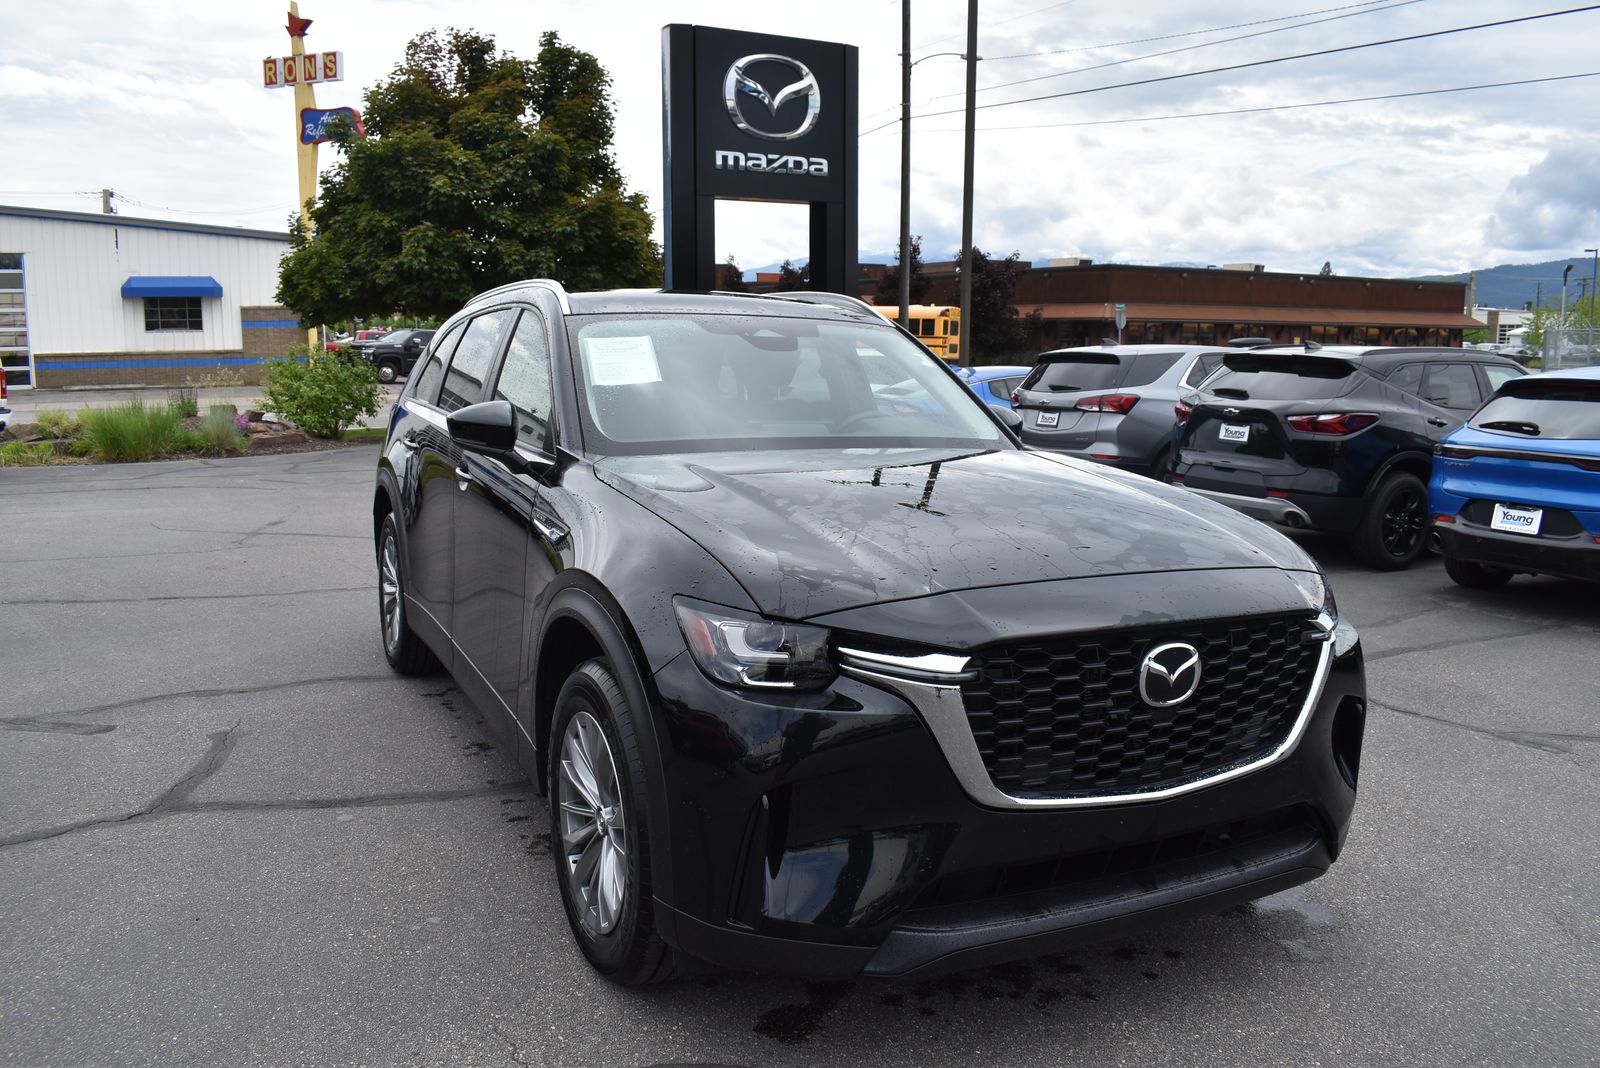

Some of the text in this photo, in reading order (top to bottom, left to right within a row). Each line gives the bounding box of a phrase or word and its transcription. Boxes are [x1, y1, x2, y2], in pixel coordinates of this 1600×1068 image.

[265, 54, 336, 84] RONS
[715, 150, 829, 176] mazda
[1224, 427, 1246, 438] Young
[1502, 510, 1534, 526] Young
